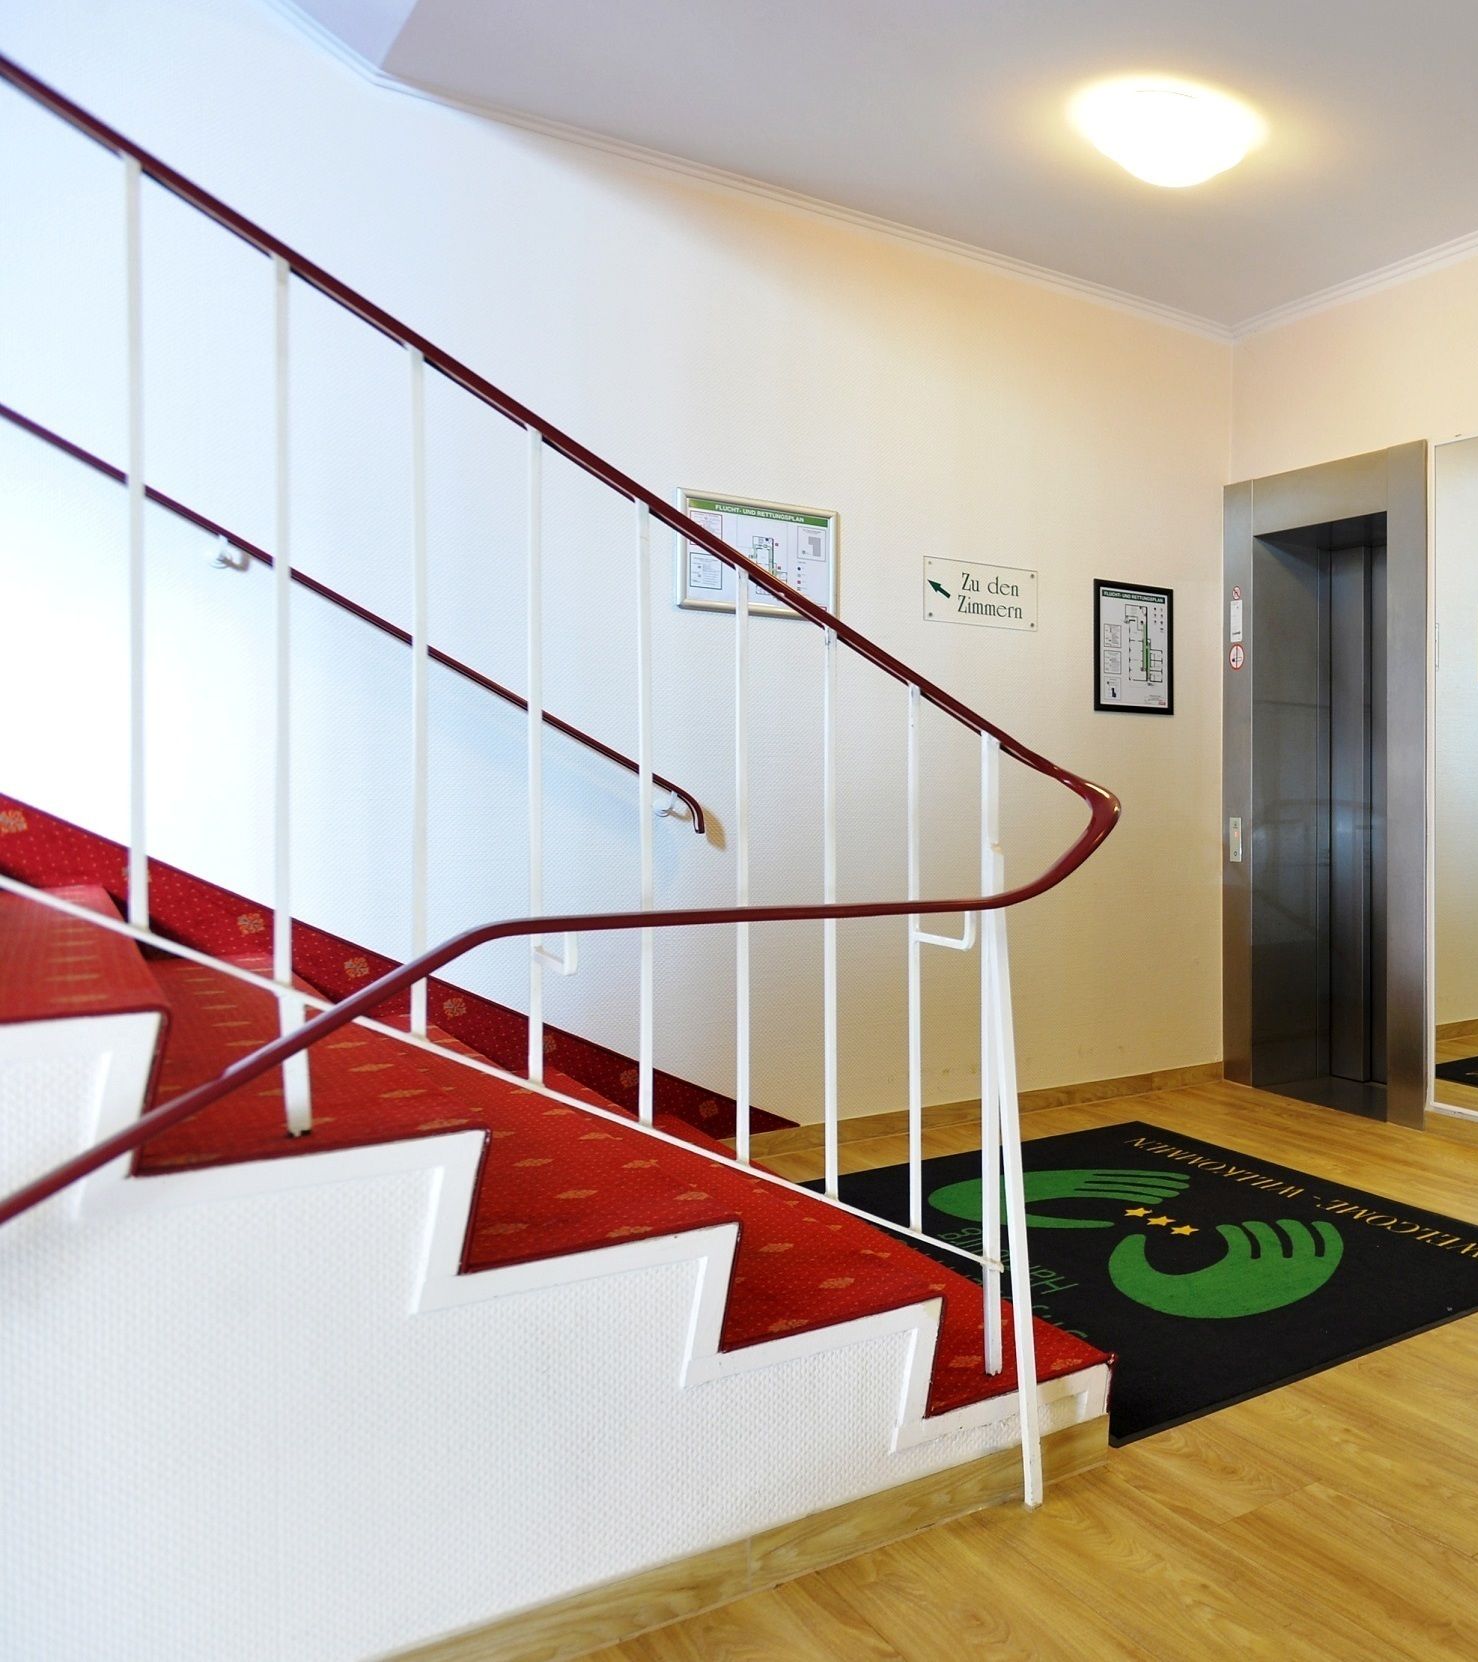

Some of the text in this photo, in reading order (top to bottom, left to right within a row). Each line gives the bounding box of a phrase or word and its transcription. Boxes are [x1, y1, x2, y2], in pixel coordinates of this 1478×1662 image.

[715, 504, 742, 514] FLUCHT-
[757, 510, 805, 522] RETTUNGSPLAN
[961, 572, 1019, 597] Zu den
[957, 594, 1023, 619] Zimmern
[1123, 1136, 1305, 1198] WILLKOMMEN
